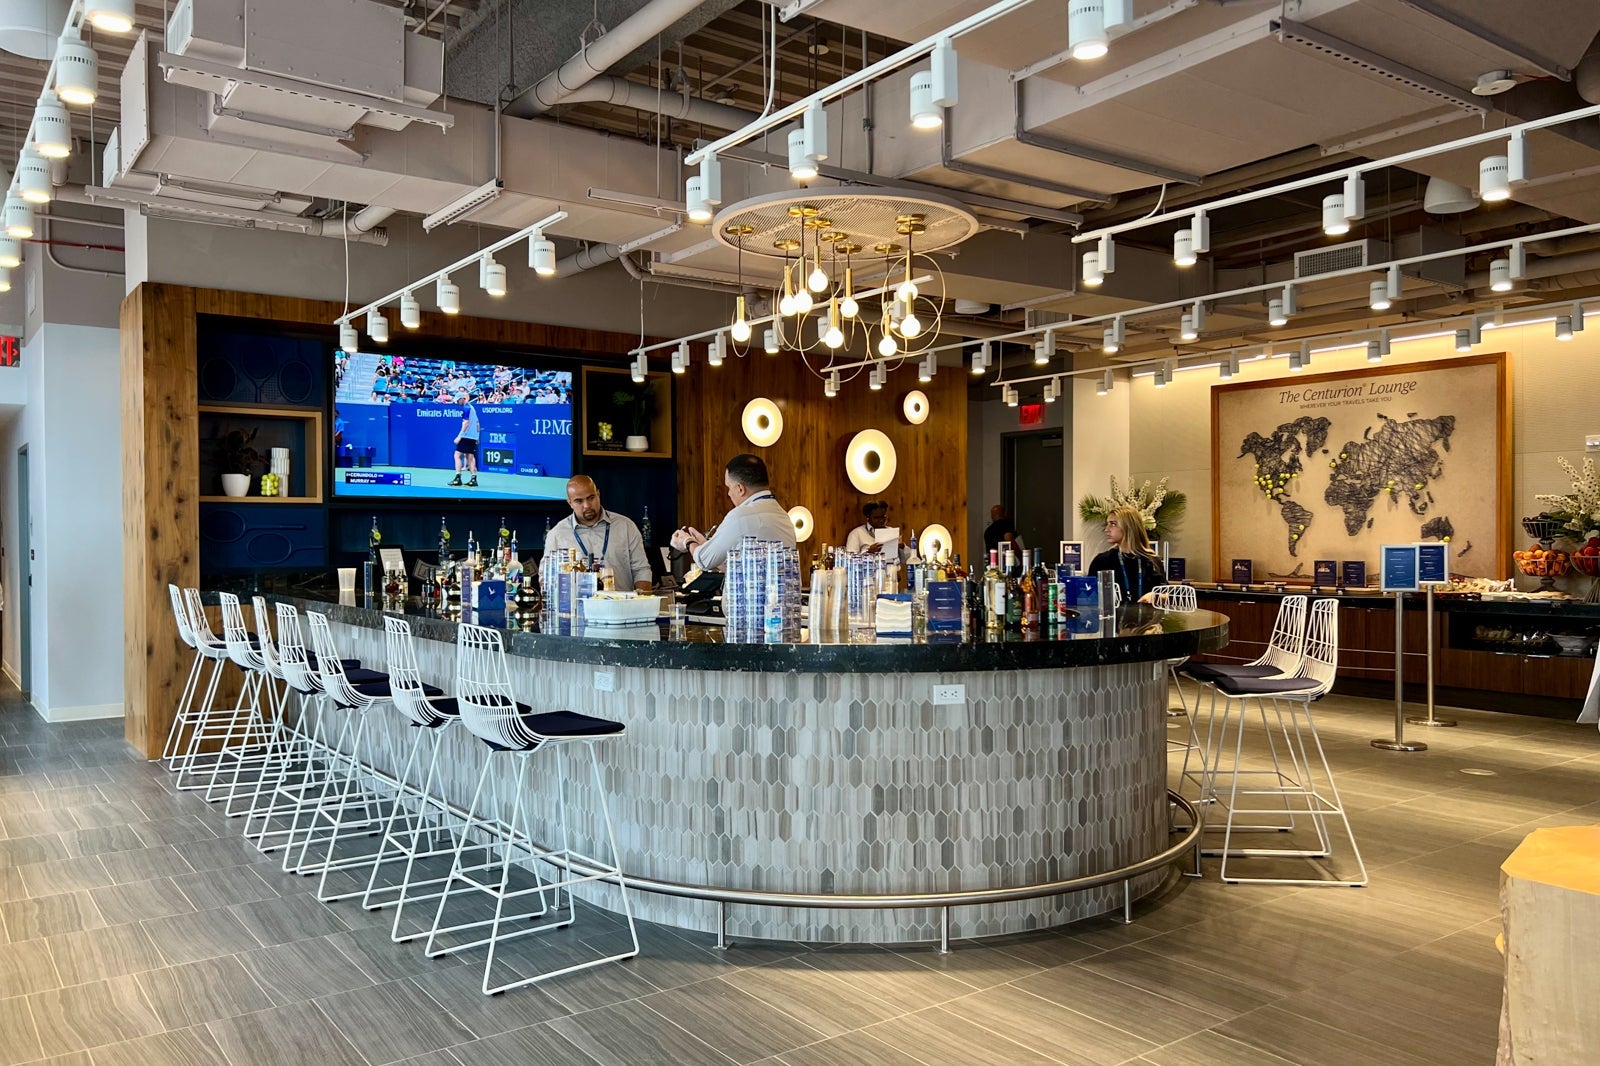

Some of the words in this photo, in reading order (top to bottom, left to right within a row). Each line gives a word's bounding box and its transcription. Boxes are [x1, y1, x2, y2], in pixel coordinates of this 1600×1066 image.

[1279, 390, 1300, 404] The
[1369, 380, 1417, 395] Lounge
[416, 408, 442, 418] Emirates
[489, 432, 507, 444] IBM
[486, 450, 501, 463] 119
